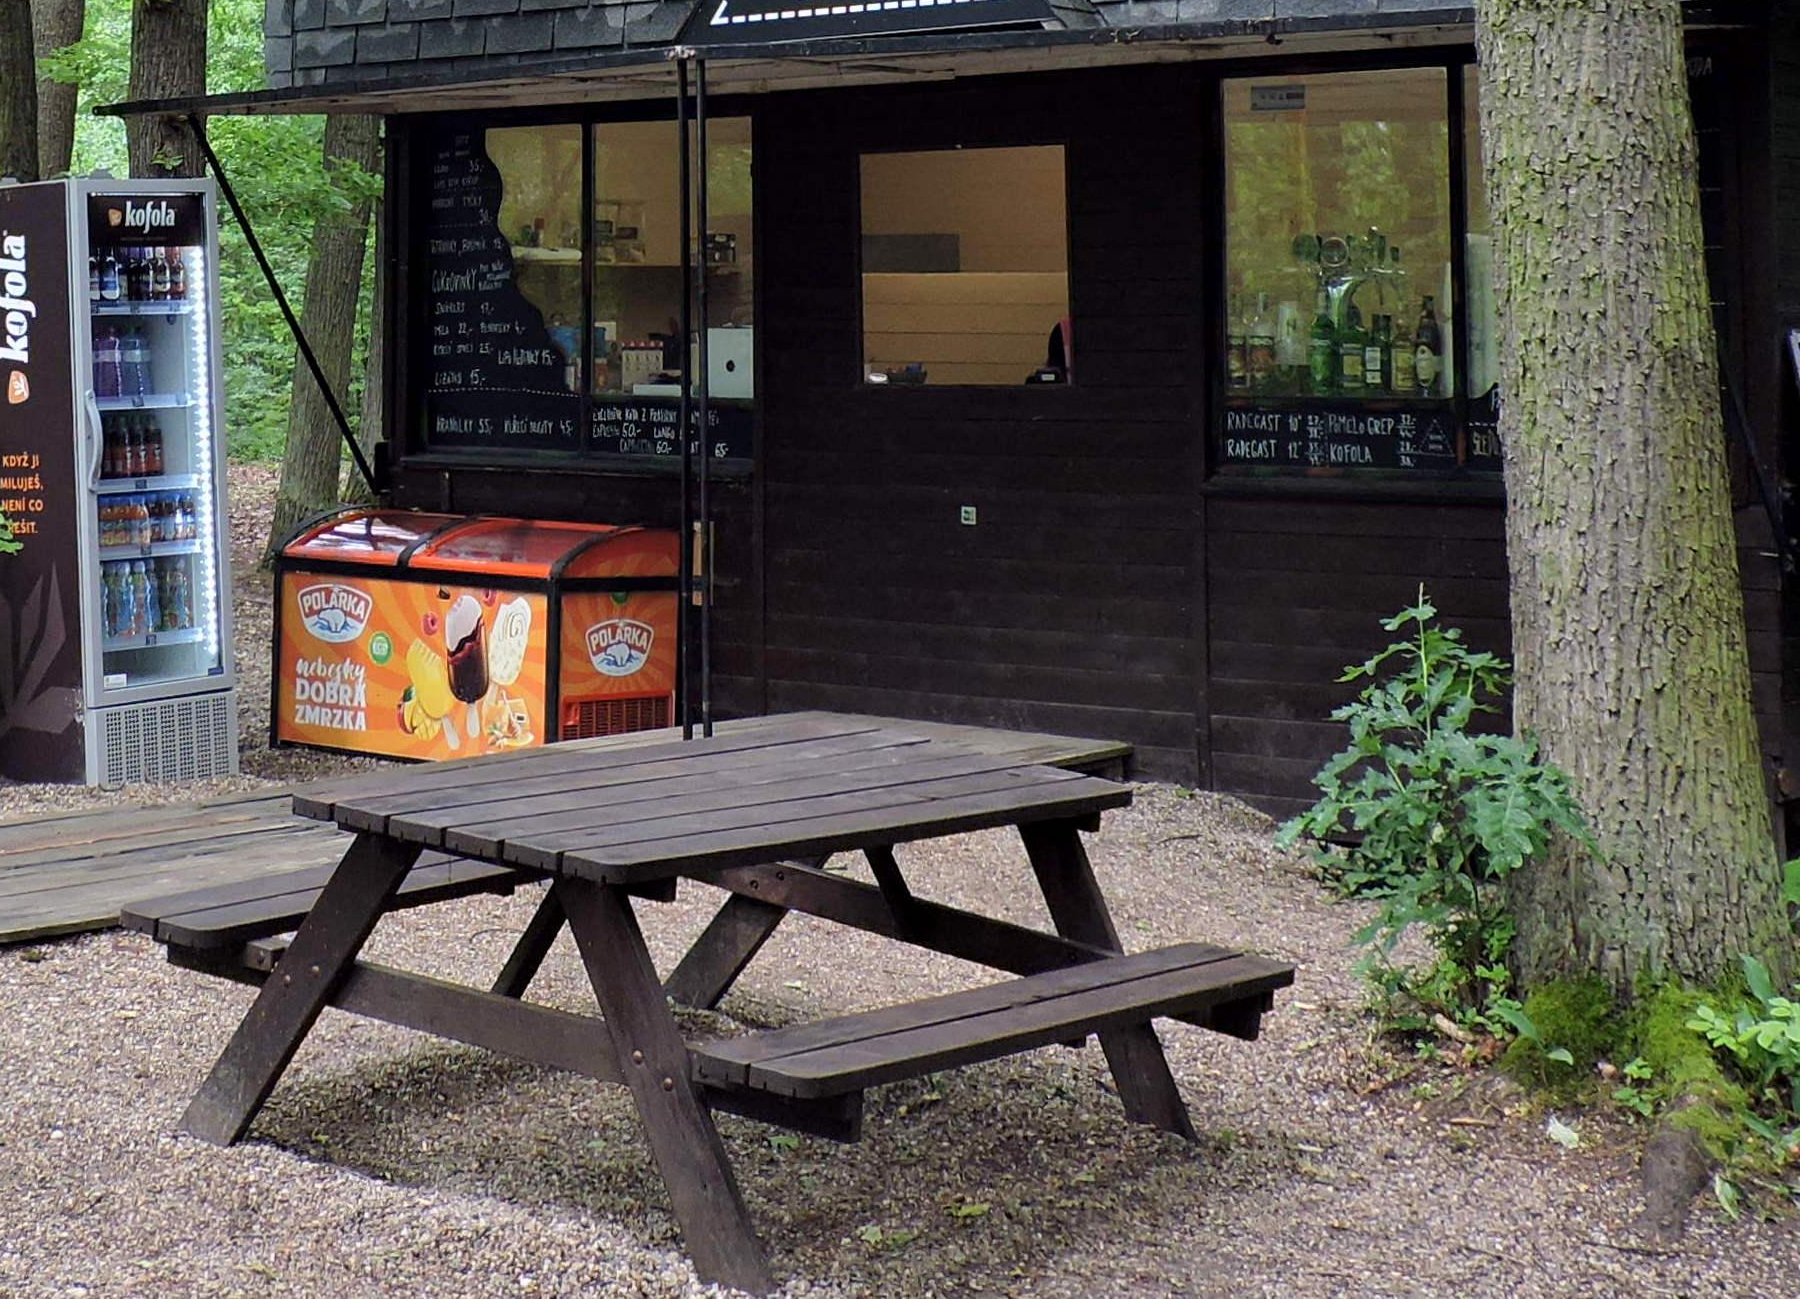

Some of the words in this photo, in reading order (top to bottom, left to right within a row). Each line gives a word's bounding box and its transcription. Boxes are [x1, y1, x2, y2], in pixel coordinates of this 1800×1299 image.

[125, 200, 176, 234] kofola
[1227, 412, 1281, 432] RADEGAST
[1227, 439, 1278, 459] RADEGAST
[1329, 444, 1373, 464] KOFOLA
[2, 451, 29, 468] KDYŽ
[31, 454, 40, 470] JI
[0, 473, 44, 492] MILUJEŠ,
[1, 497, 26, 512] NENÍ
[28, 499, 44, 512] CO
[295, 704, 367, 732] ZMRZKA
